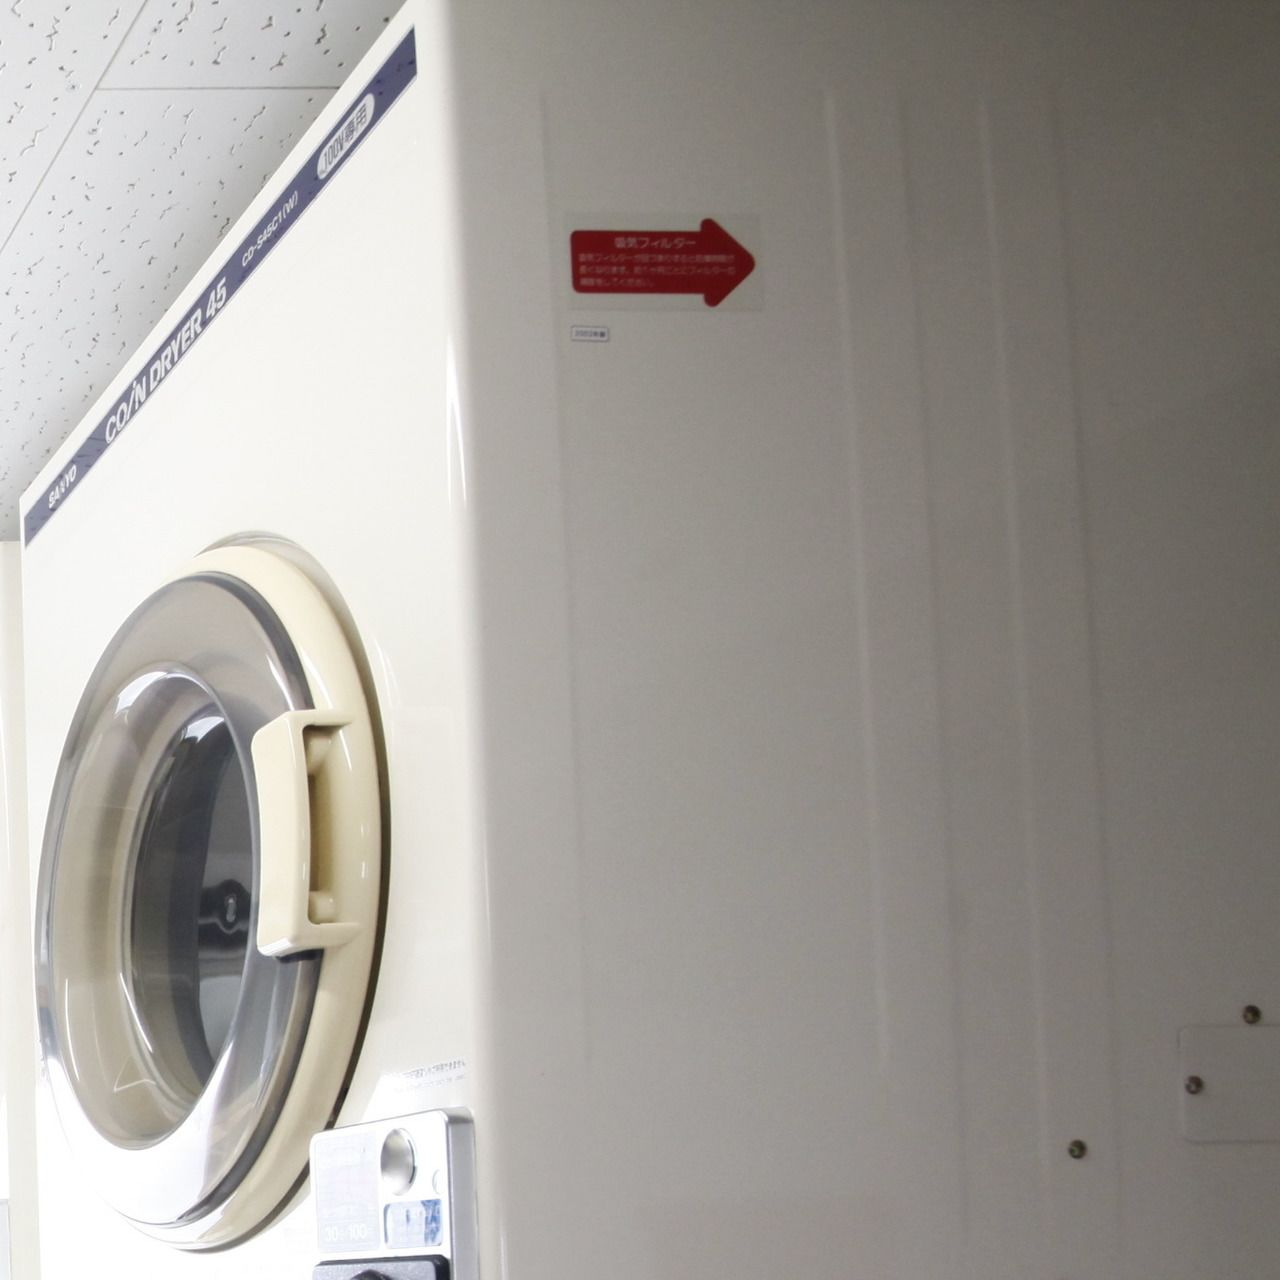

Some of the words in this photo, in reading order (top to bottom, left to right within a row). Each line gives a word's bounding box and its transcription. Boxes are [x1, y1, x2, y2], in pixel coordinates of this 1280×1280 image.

[47, 464, 78, 510] SANYO
[148, 306, 205, 388] DRYER
[204, 276, 229, 319] 45
